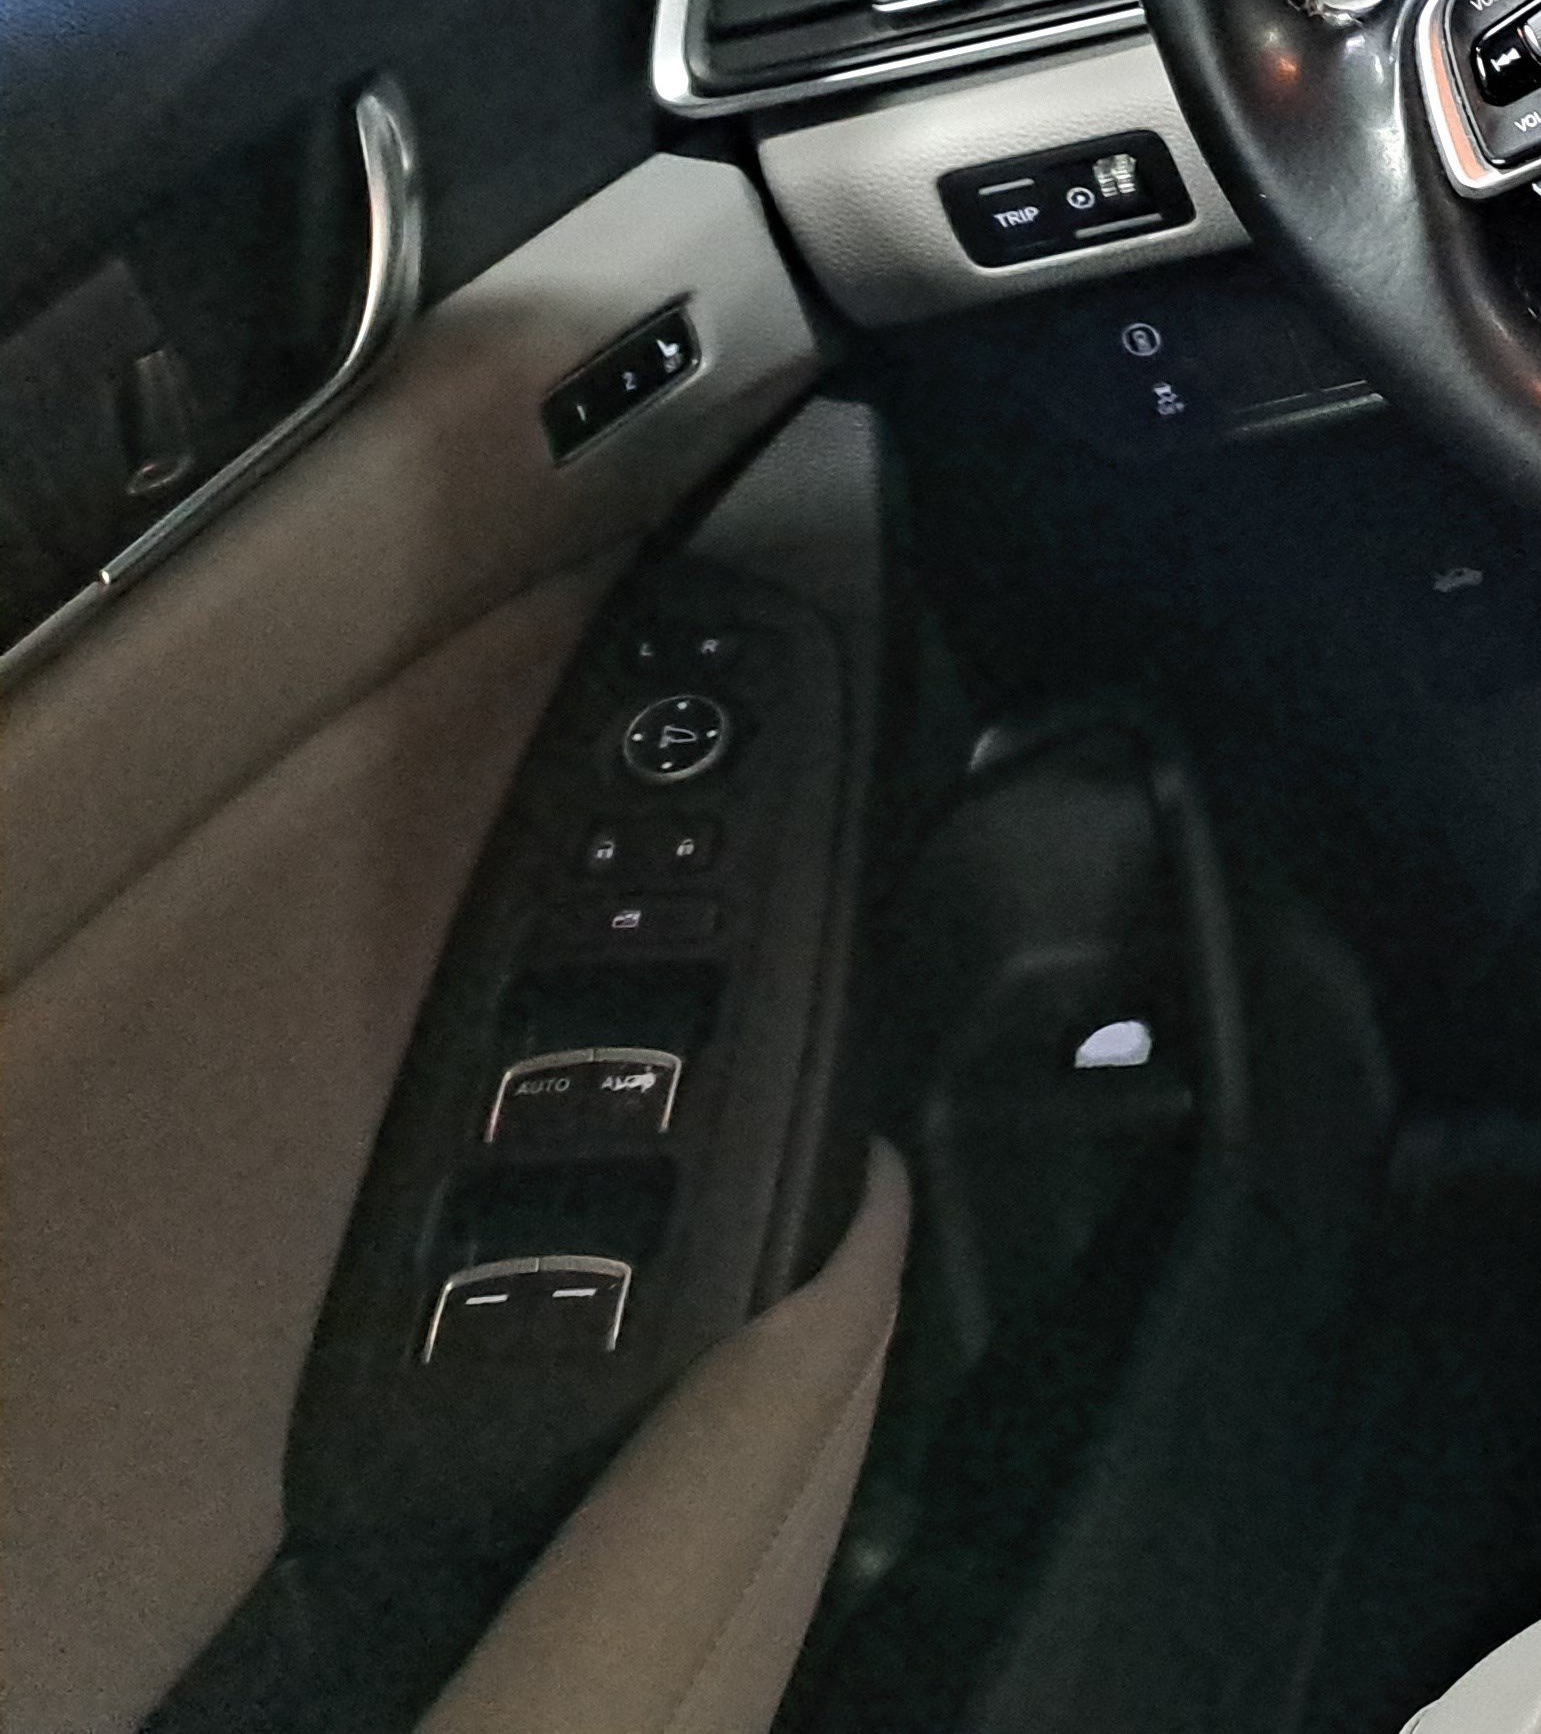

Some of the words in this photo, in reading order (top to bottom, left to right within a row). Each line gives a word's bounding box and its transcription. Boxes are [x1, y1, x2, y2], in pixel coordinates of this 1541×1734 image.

[993, 206, 1040, 228] TRIP
[622, 371, 637, 392] 2
[514, 1077, 571, 1096] AUTO
